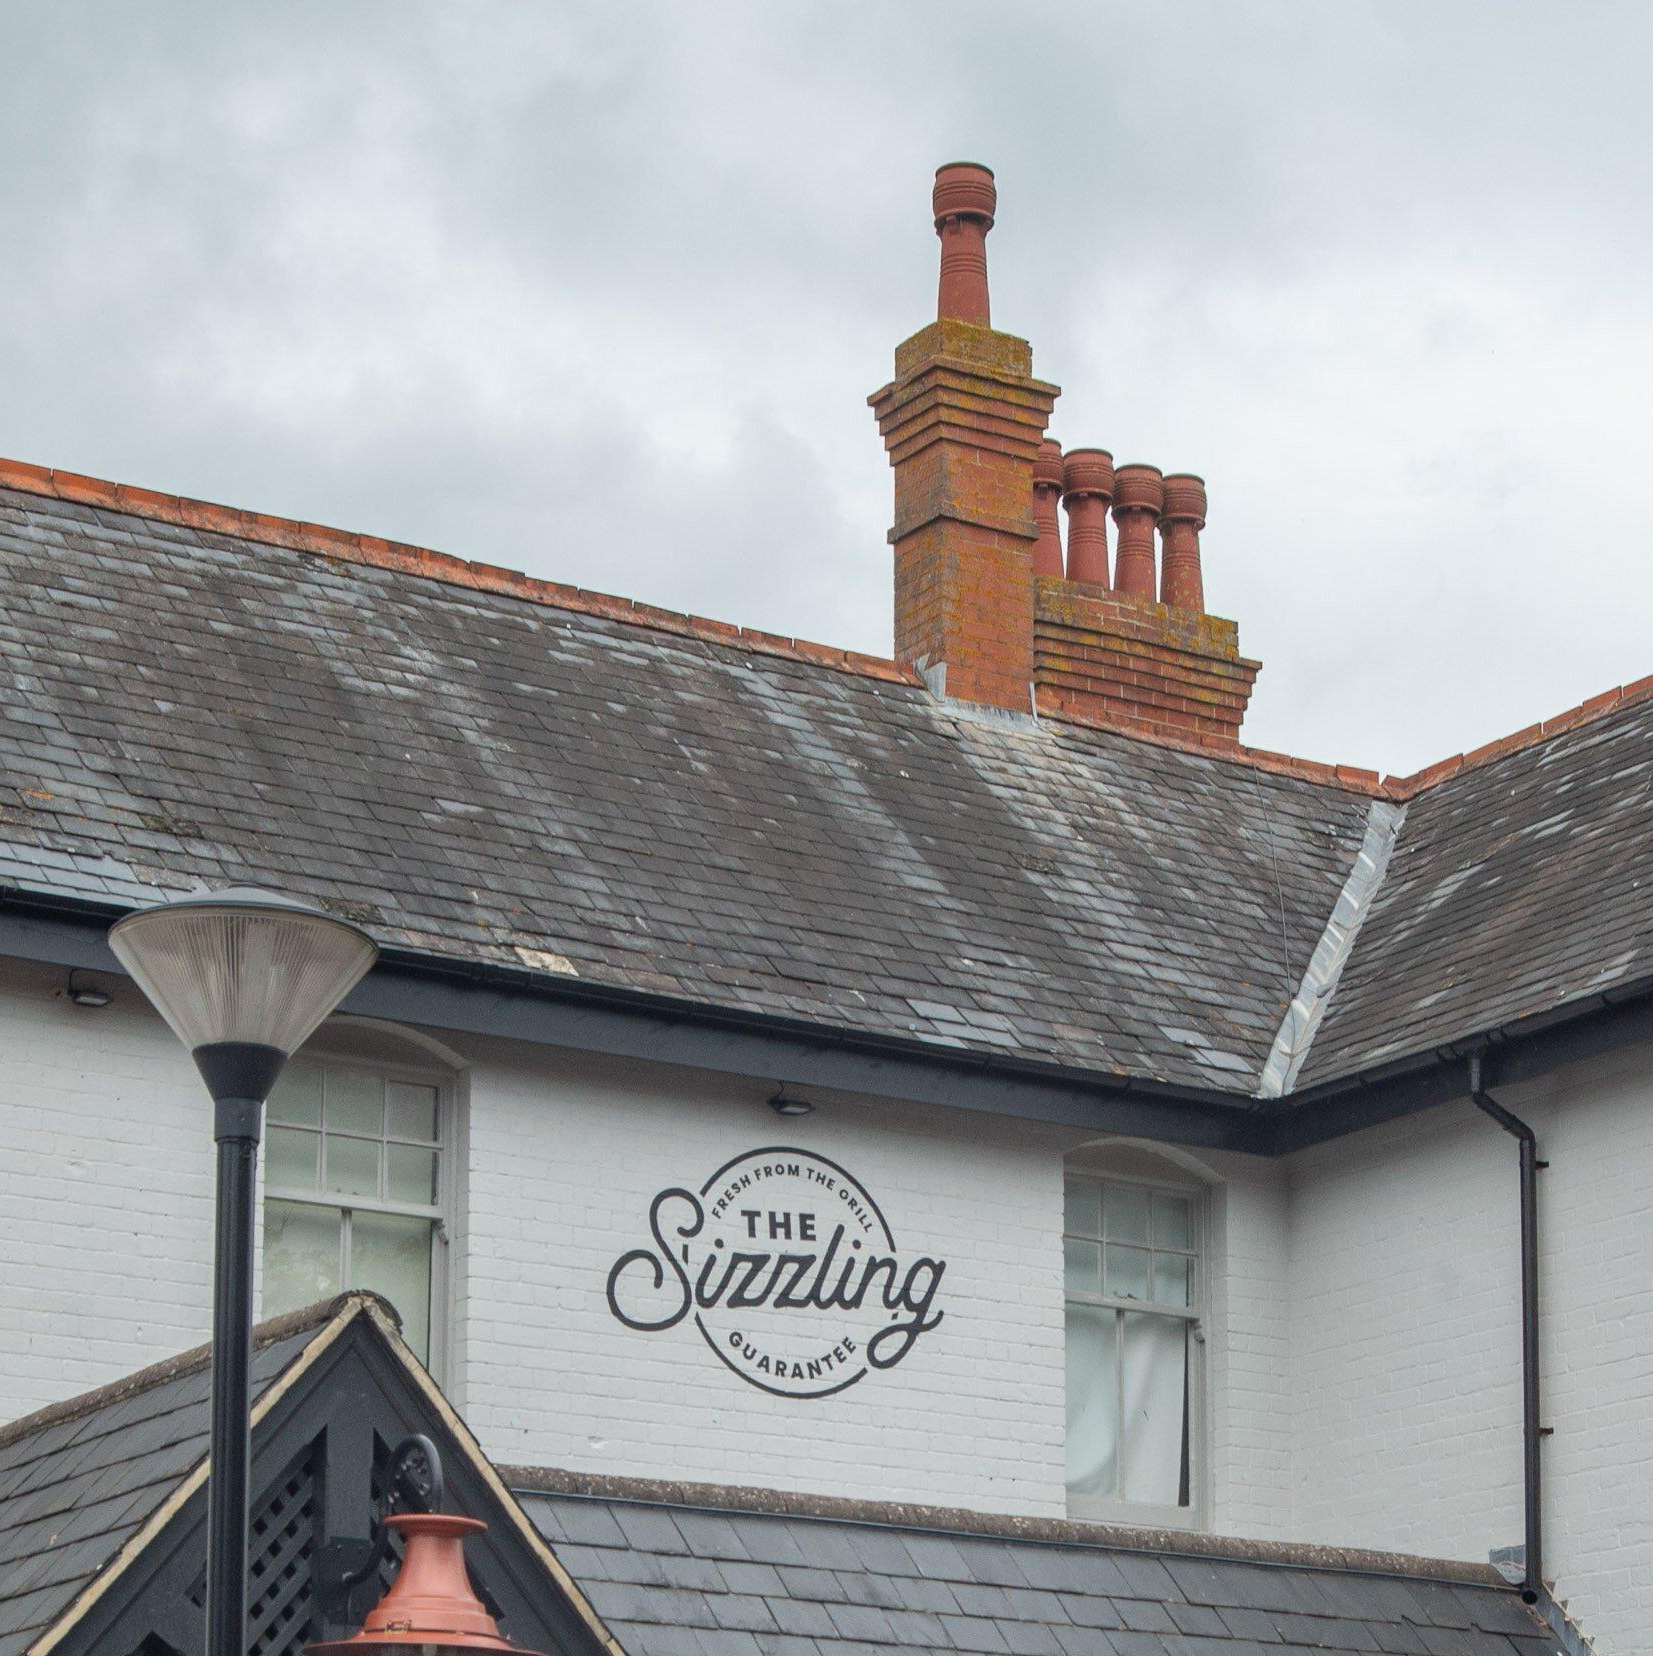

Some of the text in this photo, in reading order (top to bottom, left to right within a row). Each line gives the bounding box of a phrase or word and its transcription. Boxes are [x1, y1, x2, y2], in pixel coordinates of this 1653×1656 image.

[712, 1164, 873, 1234] FRESH FROM THE GRILL
[741, 1209, 817, 1241] THE
[606, 1187, 947, 1370] Sizzling
[729, 1331, 857, 1380] GUARANTEE
